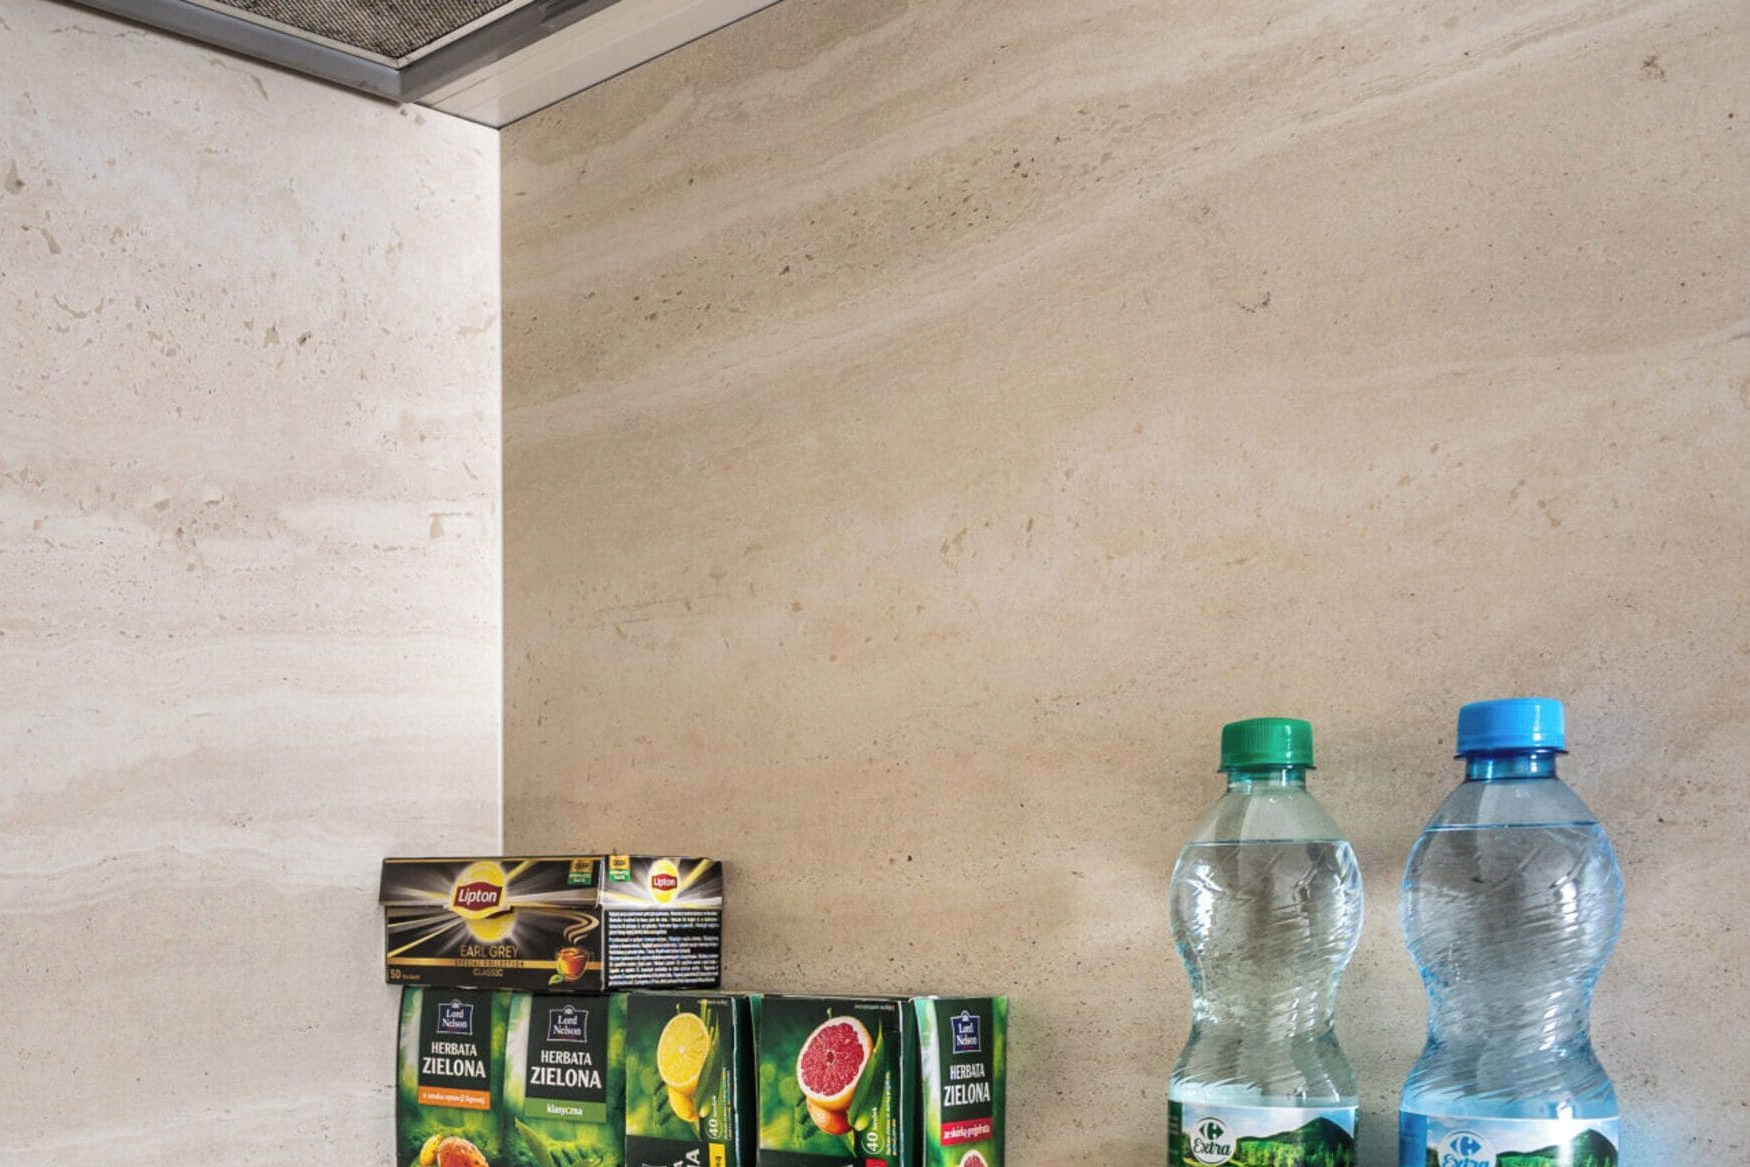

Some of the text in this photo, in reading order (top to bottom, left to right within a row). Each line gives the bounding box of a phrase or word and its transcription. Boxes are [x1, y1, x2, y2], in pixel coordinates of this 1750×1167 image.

[457, 888, 498, 904] Lipton
[460, 945, 520, 958] EARL GREY
[446, 1009, 465, 1018] Lord
[558, 1015, 578, 1025] Lord
[442, 1018, 468, 1028] Nelson
[553, 1025, 581, 1035] Nelson
[431, 1041, 478, 1057] HERBATA
[541, 1050, 592, 1066] HERBATA
[422, 1057, 487, 1078] ZIELONA
[950, 1063, 985, 1081] HERBATA
[530, 1066, 602, 1089] ZIELONA
[943, 1082, 991, 1107] ZIELONA
[547, 1103, 583, 1116] klasyczna
[709, 1118, 719, 1137] 40
[866, 1132, 879, 1152] 40
[1192, 1138, 1232, 1157] Extra
